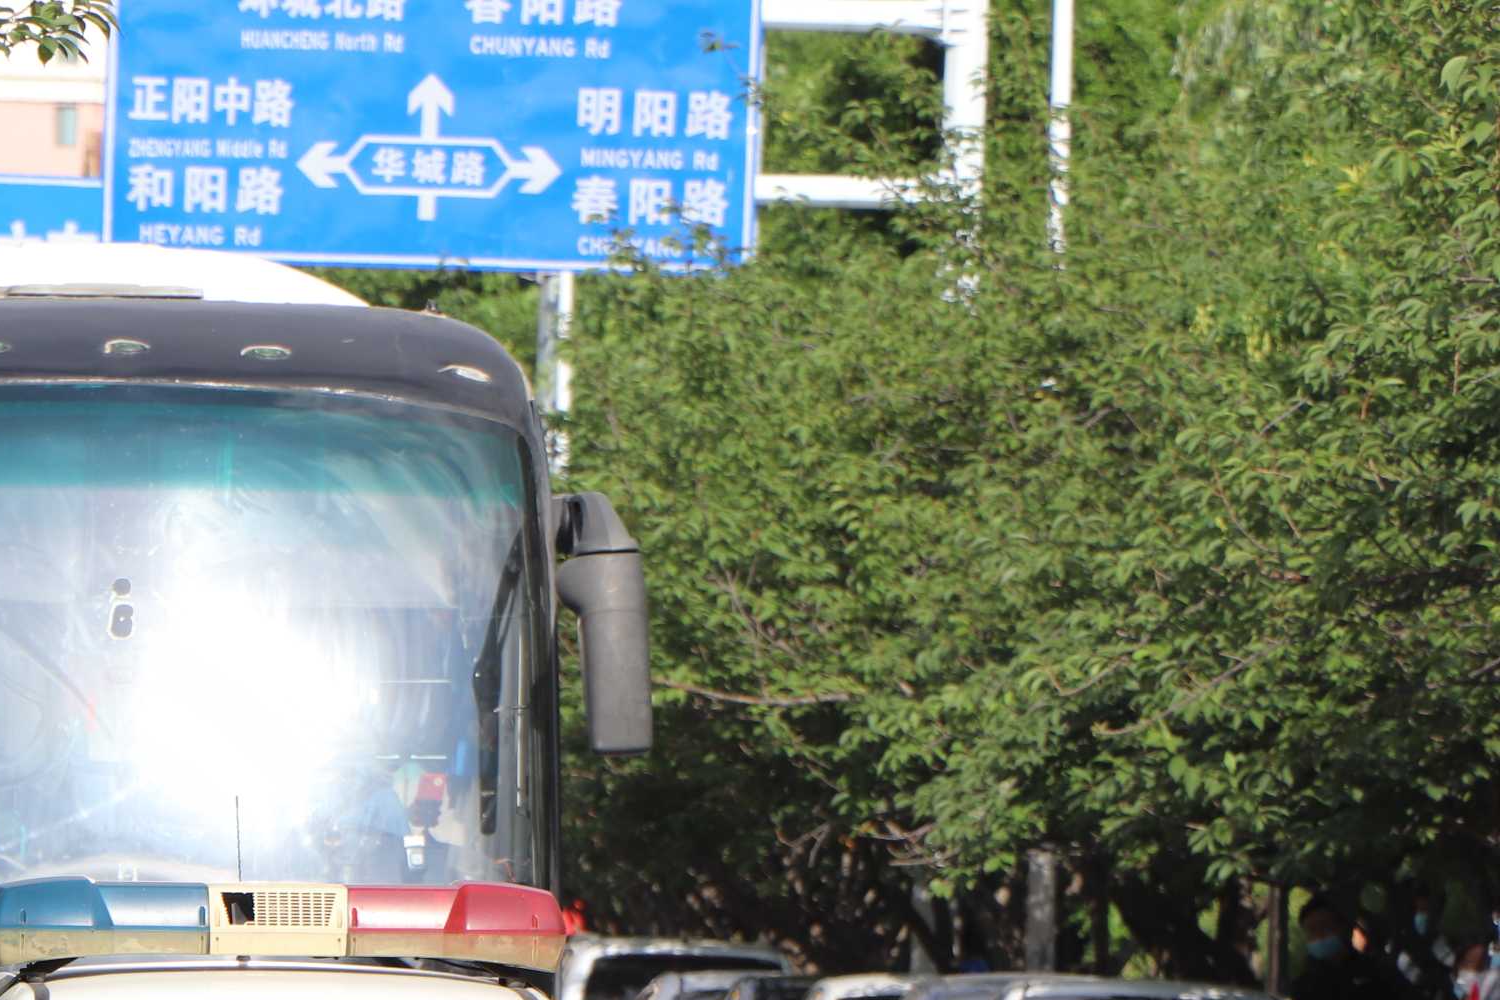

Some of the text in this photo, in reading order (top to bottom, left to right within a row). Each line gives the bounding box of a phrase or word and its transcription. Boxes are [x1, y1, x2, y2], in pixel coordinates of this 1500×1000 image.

[384, 33, 404, 53] Rd
[469, 35, 611, 58] CHUNYANG Rd
[128, 76, 295, 127] 正阳中路
[576, 87, 733, 139] 明阳路
[268, 140, 288, 159] Rd
[580, 149, 719, 171] MINGYANG Rd
[371, 146, 486, 186] 华城路
[126, 164, 284, 215] 和阳路
[138, 224, 262, 246] HEYANG Rd
